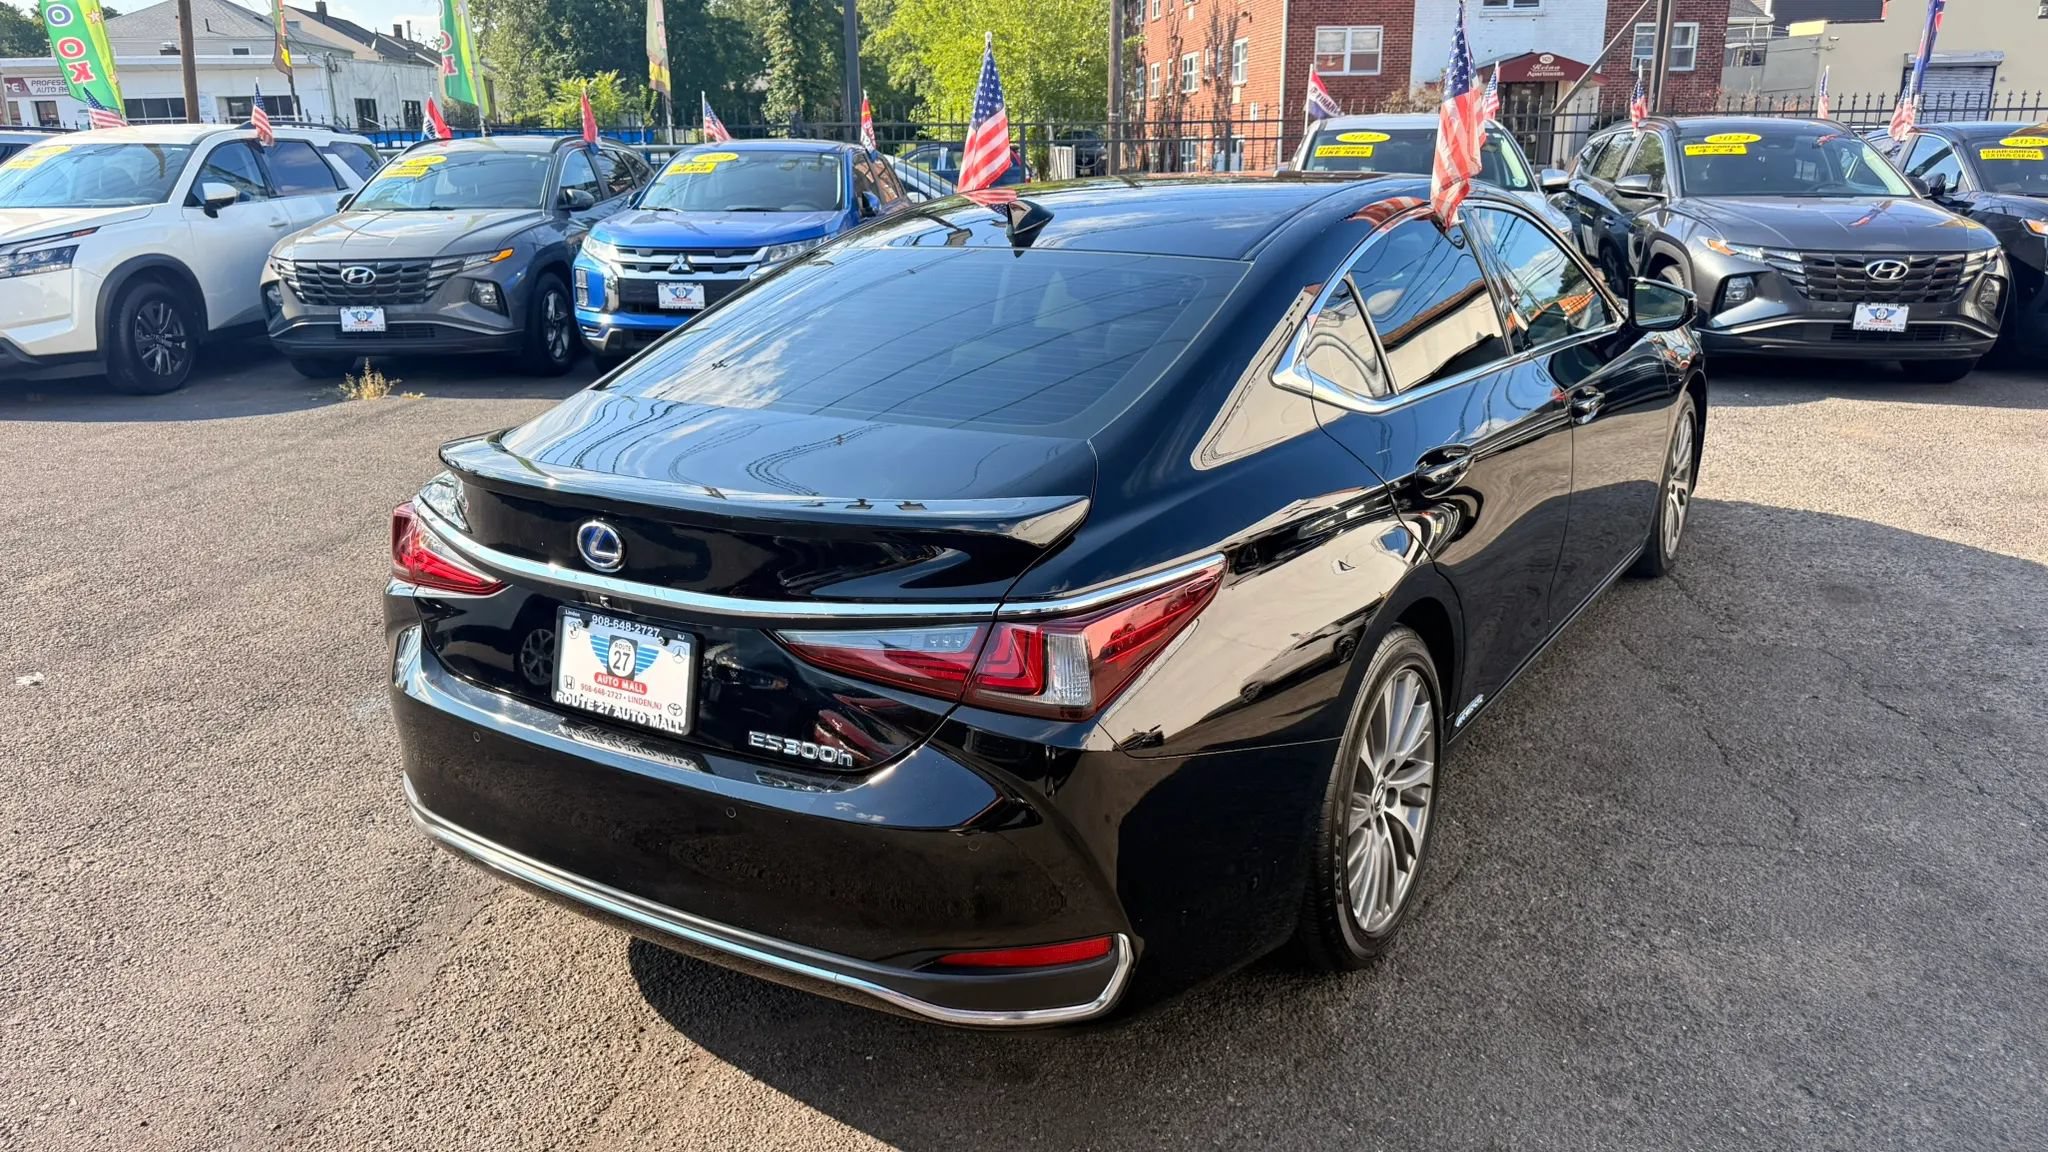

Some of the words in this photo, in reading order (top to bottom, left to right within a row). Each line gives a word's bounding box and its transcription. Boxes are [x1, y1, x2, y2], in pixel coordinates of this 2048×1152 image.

[565, 609, 580, 617] Linden
[592, 614, 660, 638] 908-648-2727
[614, 642, 632, 652] ROUTE
[613, 650, 631, 671] 27
[580, 683, 622, 699] 908-648-2727
[597, 674, 619, 688] AUTO
[621, 679, 645, 694] MALL
[555, 690, 595, 711] ROUTE
[596, 701, 612, 715] 27
[613, 706, 647, 725] AUTO
[647, 713, 683, 735] MALL
[748, 730, 853, 767] ES300h
